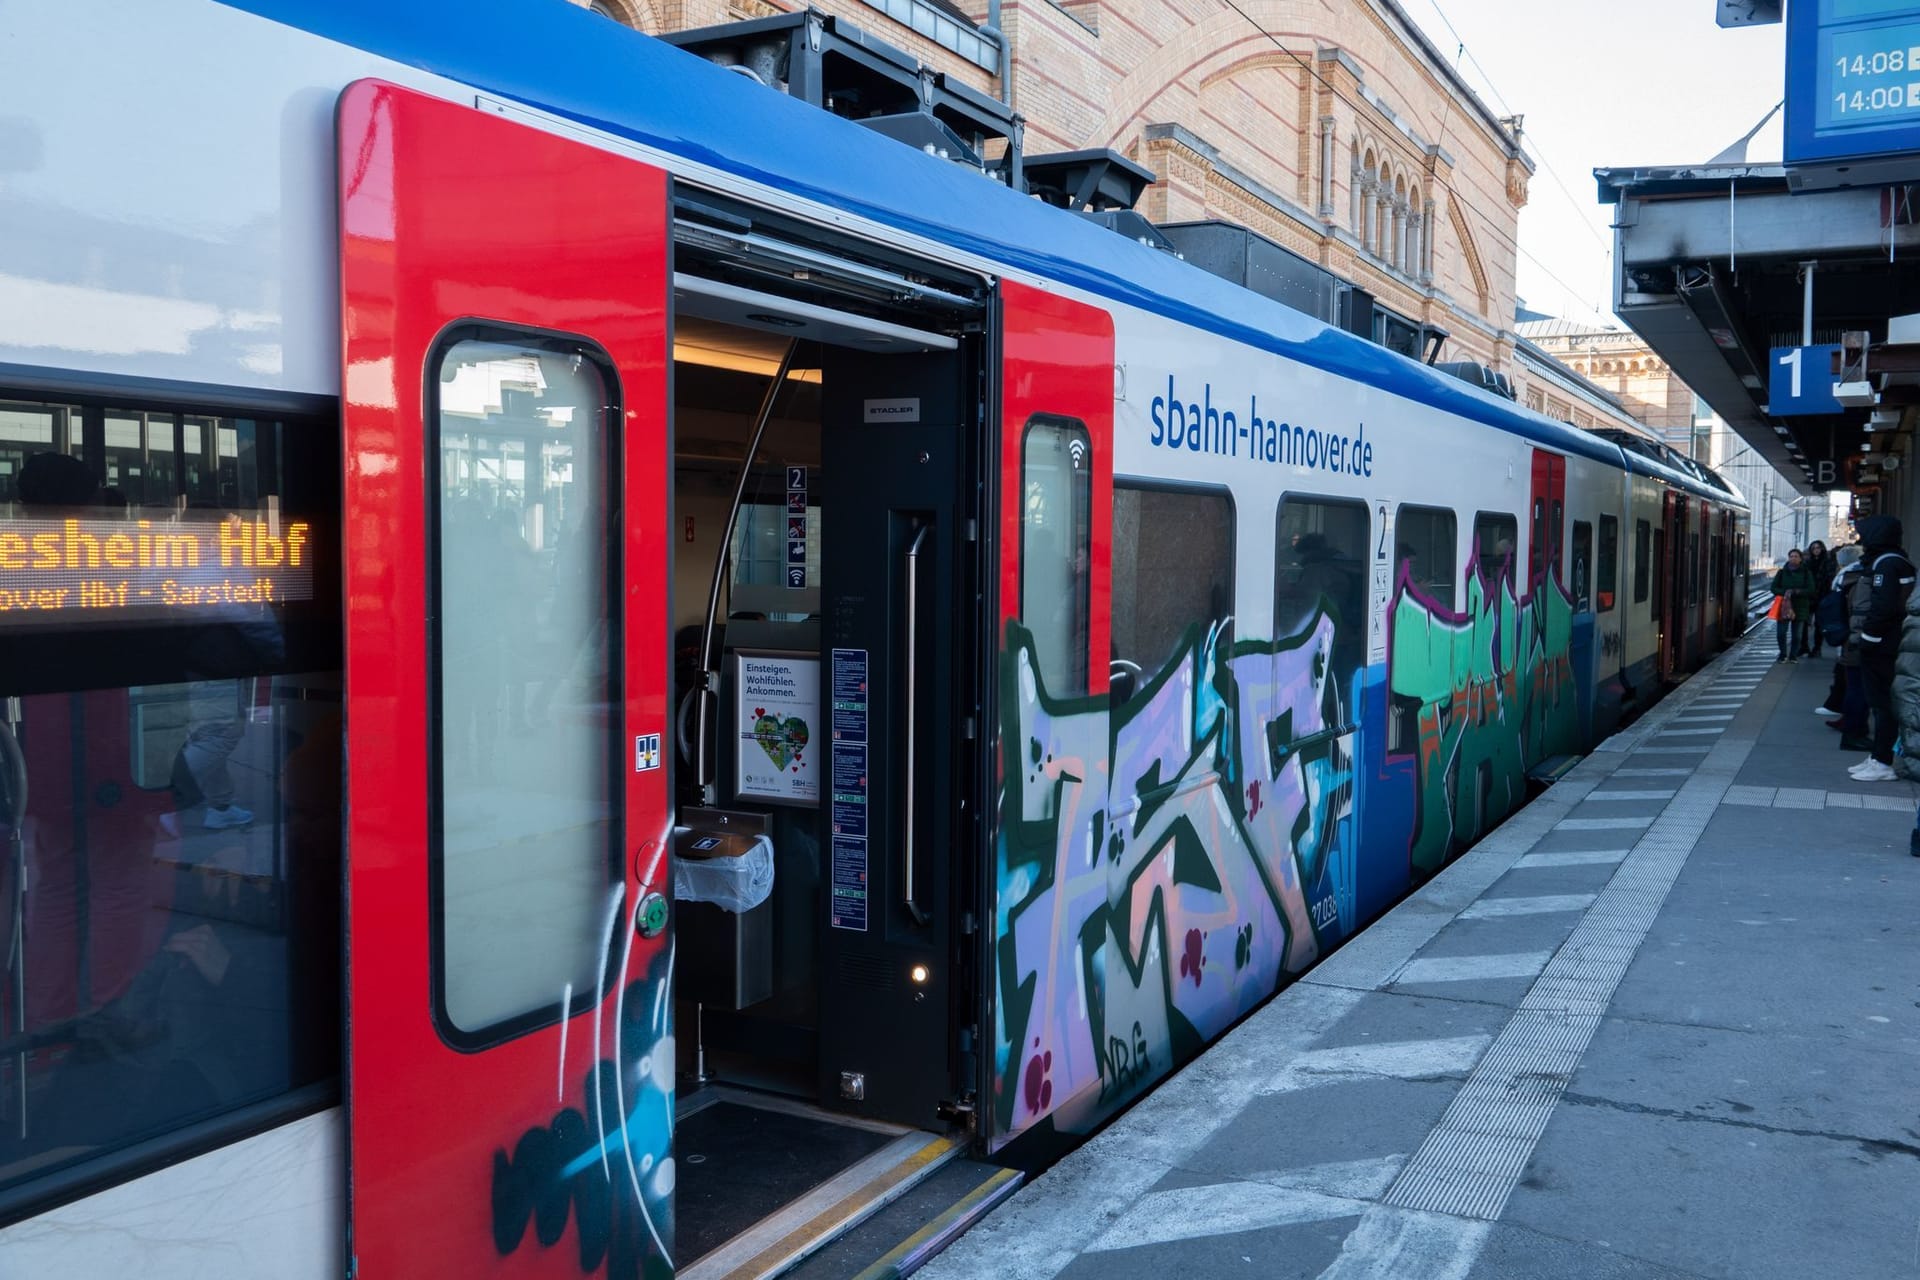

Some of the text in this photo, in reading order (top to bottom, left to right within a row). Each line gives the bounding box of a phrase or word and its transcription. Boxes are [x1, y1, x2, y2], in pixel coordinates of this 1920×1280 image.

[1835, 50, 1904, 77] 14:08
[1834, 86, 1903, 113] 14:00
[1780, 348, 1802, 397] 1
[870, 406, 914, 414] STADLER
[1151, 375, 1373, 477] sbahn-hannover.de
[792, 469, 802, 488] 2
[1818, 461, 1836, 484] B
[0, 519, 309, 568] esheim Hbf
[1377, 506, 1387, 560] 2
[80, 580, 128, 608] Hbf
[161, 578, 274, 605] Sarstedt
[746, 664, 792, 676] Einsteigen.
[746, 675, 796, 687] Wohlfühlen.
[746, 686, 796, 697] Ankommen.
